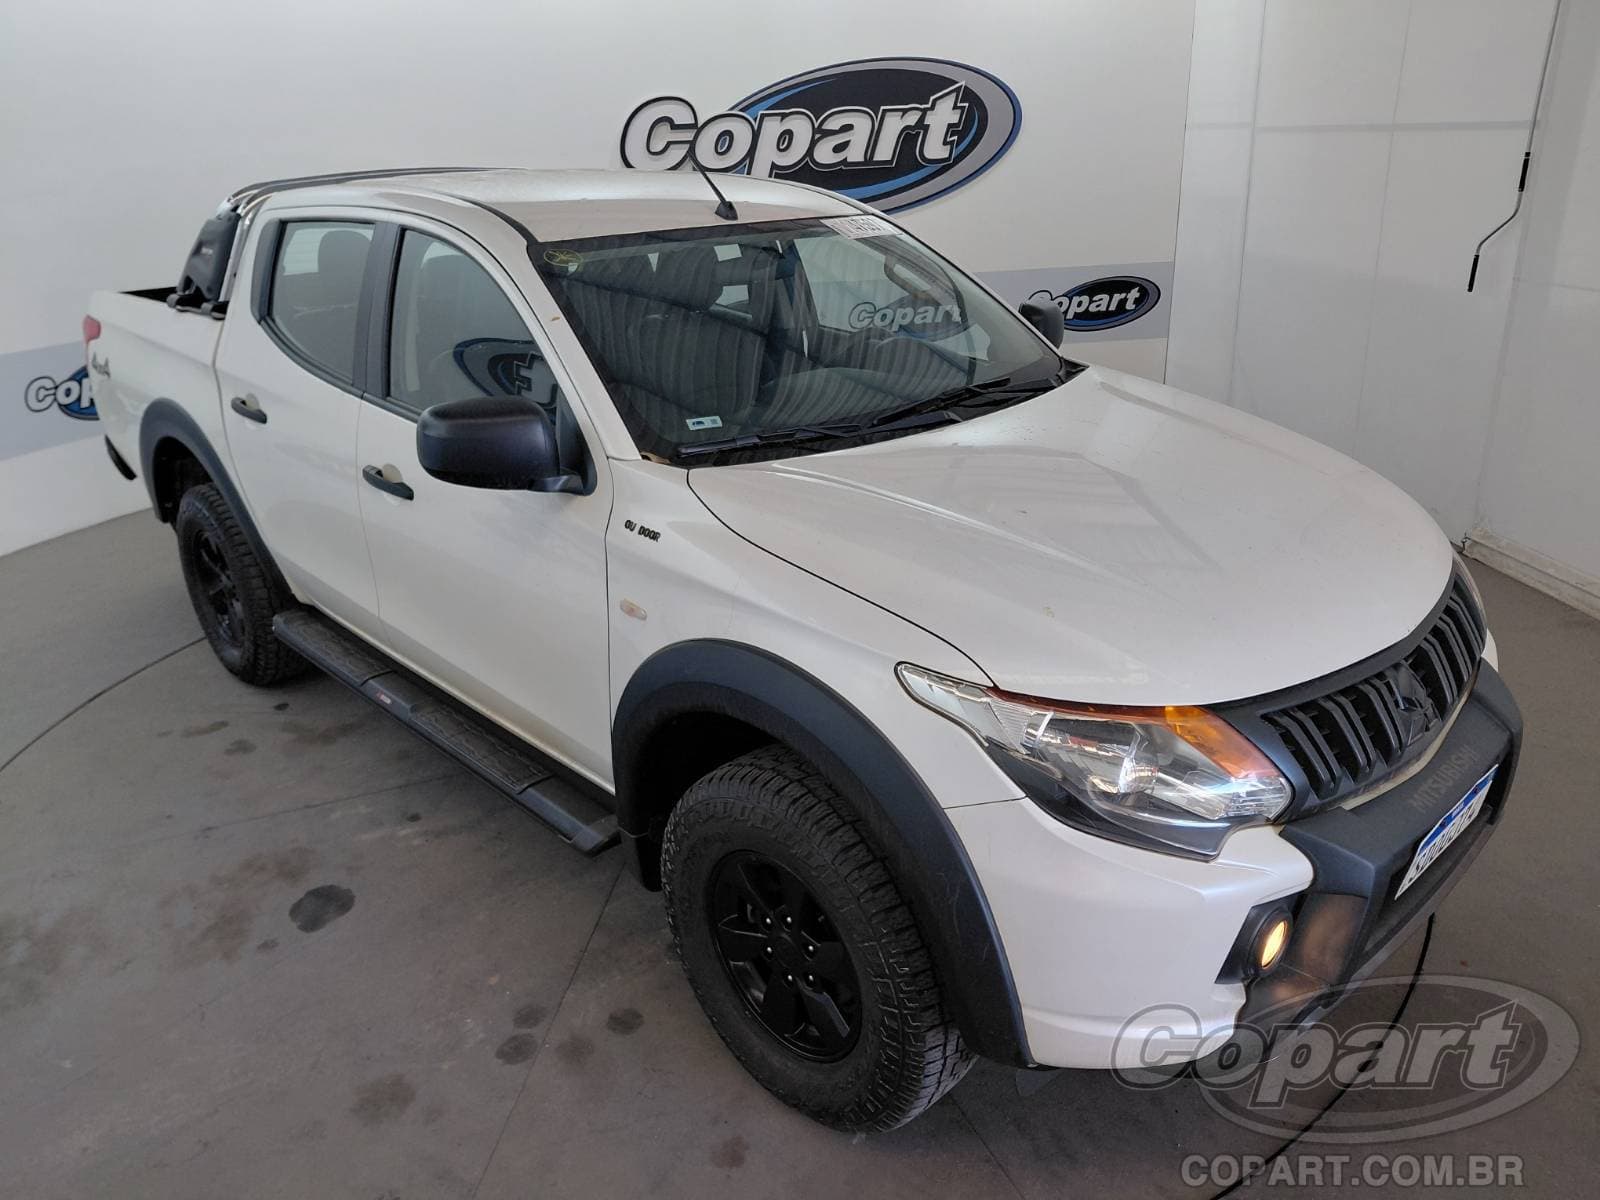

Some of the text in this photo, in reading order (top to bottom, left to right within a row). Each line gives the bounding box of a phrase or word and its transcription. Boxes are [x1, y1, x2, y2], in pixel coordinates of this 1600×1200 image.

[619, 81, 969, 179] Copart
[638, 525, 661, 542] DOOR
[1410, 745, 1480, 813] MITSUBISHI
